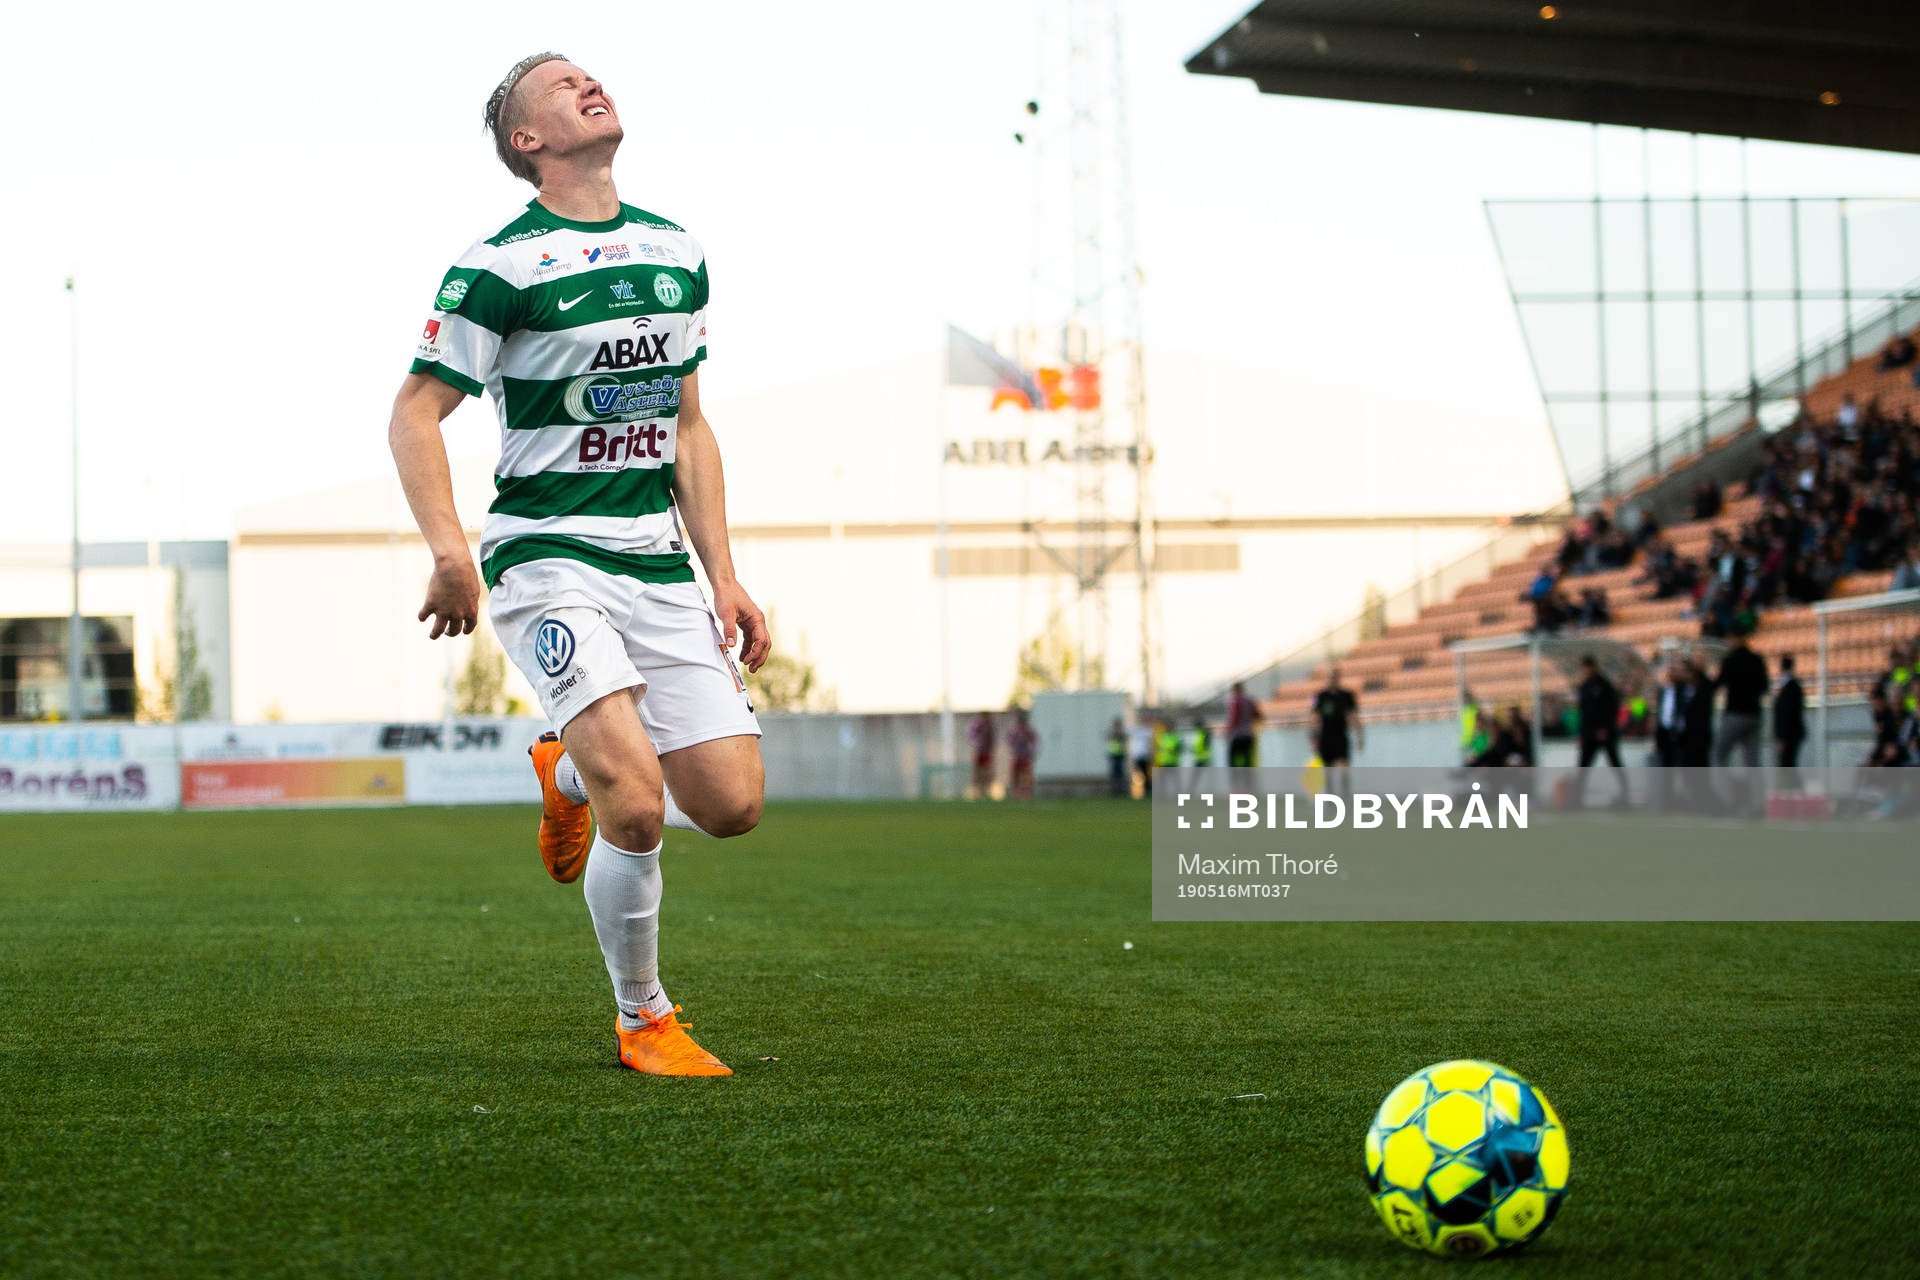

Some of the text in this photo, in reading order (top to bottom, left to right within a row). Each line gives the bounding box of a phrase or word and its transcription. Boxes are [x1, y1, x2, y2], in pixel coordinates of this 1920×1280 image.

[601, 244, 629, 254] INTER
[604, 252, 631, 261] SPORT
[590, 333, 670, 371] ABAX
[578, 423, 662, 463] Britt
